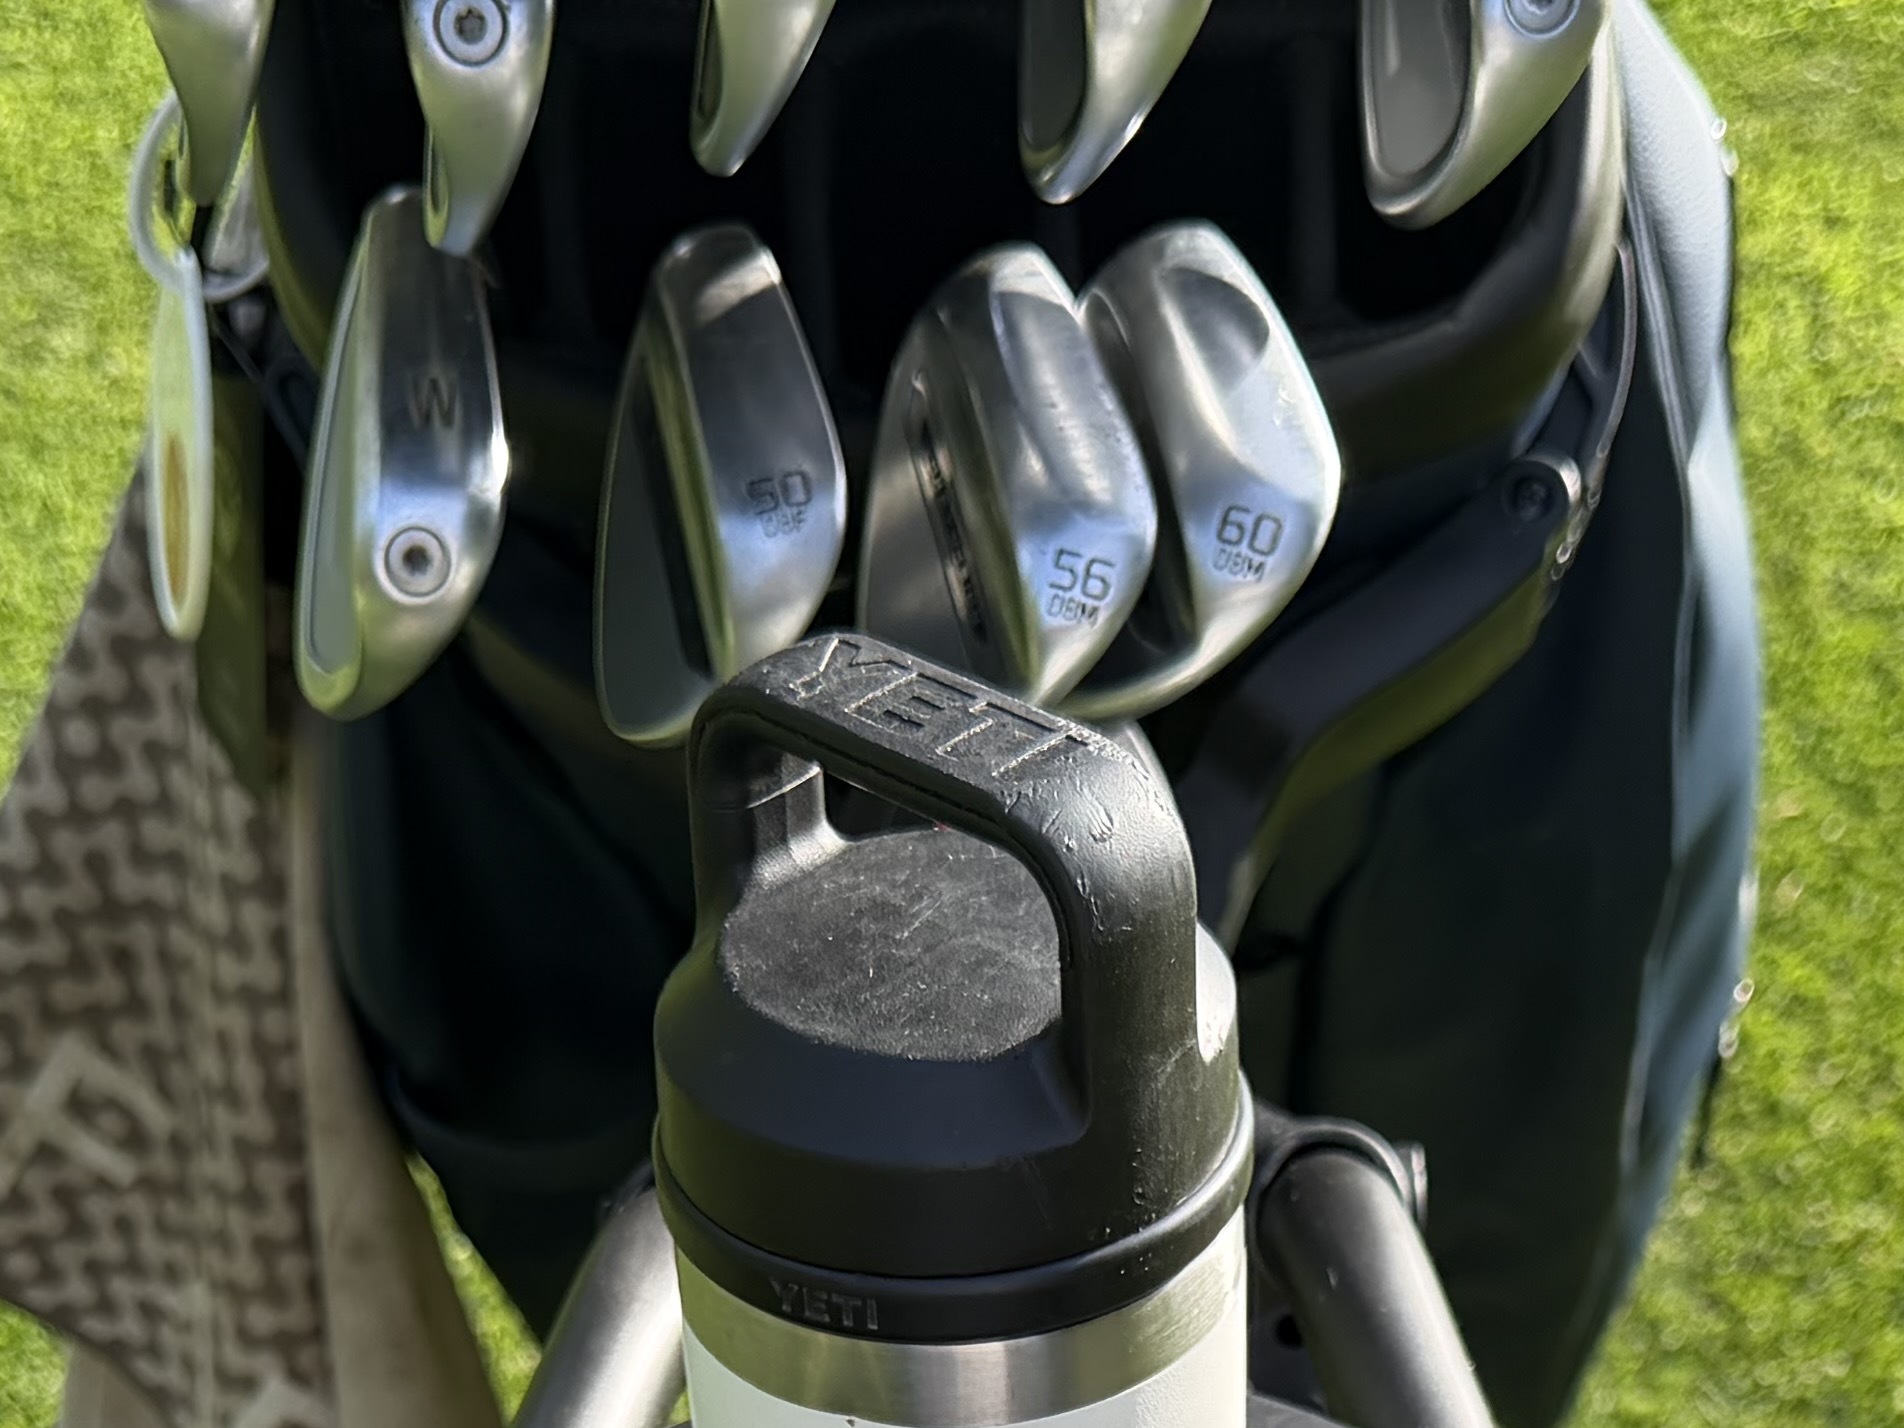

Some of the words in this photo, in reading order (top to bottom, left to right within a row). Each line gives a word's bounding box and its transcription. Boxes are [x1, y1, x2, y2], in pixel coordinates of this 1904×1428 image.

[744, 469, 812, 516] 50
[1217, 505, 1283, 556] 60
[1049, 548, 1116, 602] 56
[789, 638, 1090, 782] YETI
[769, 1276, 879, 1331] YETI
